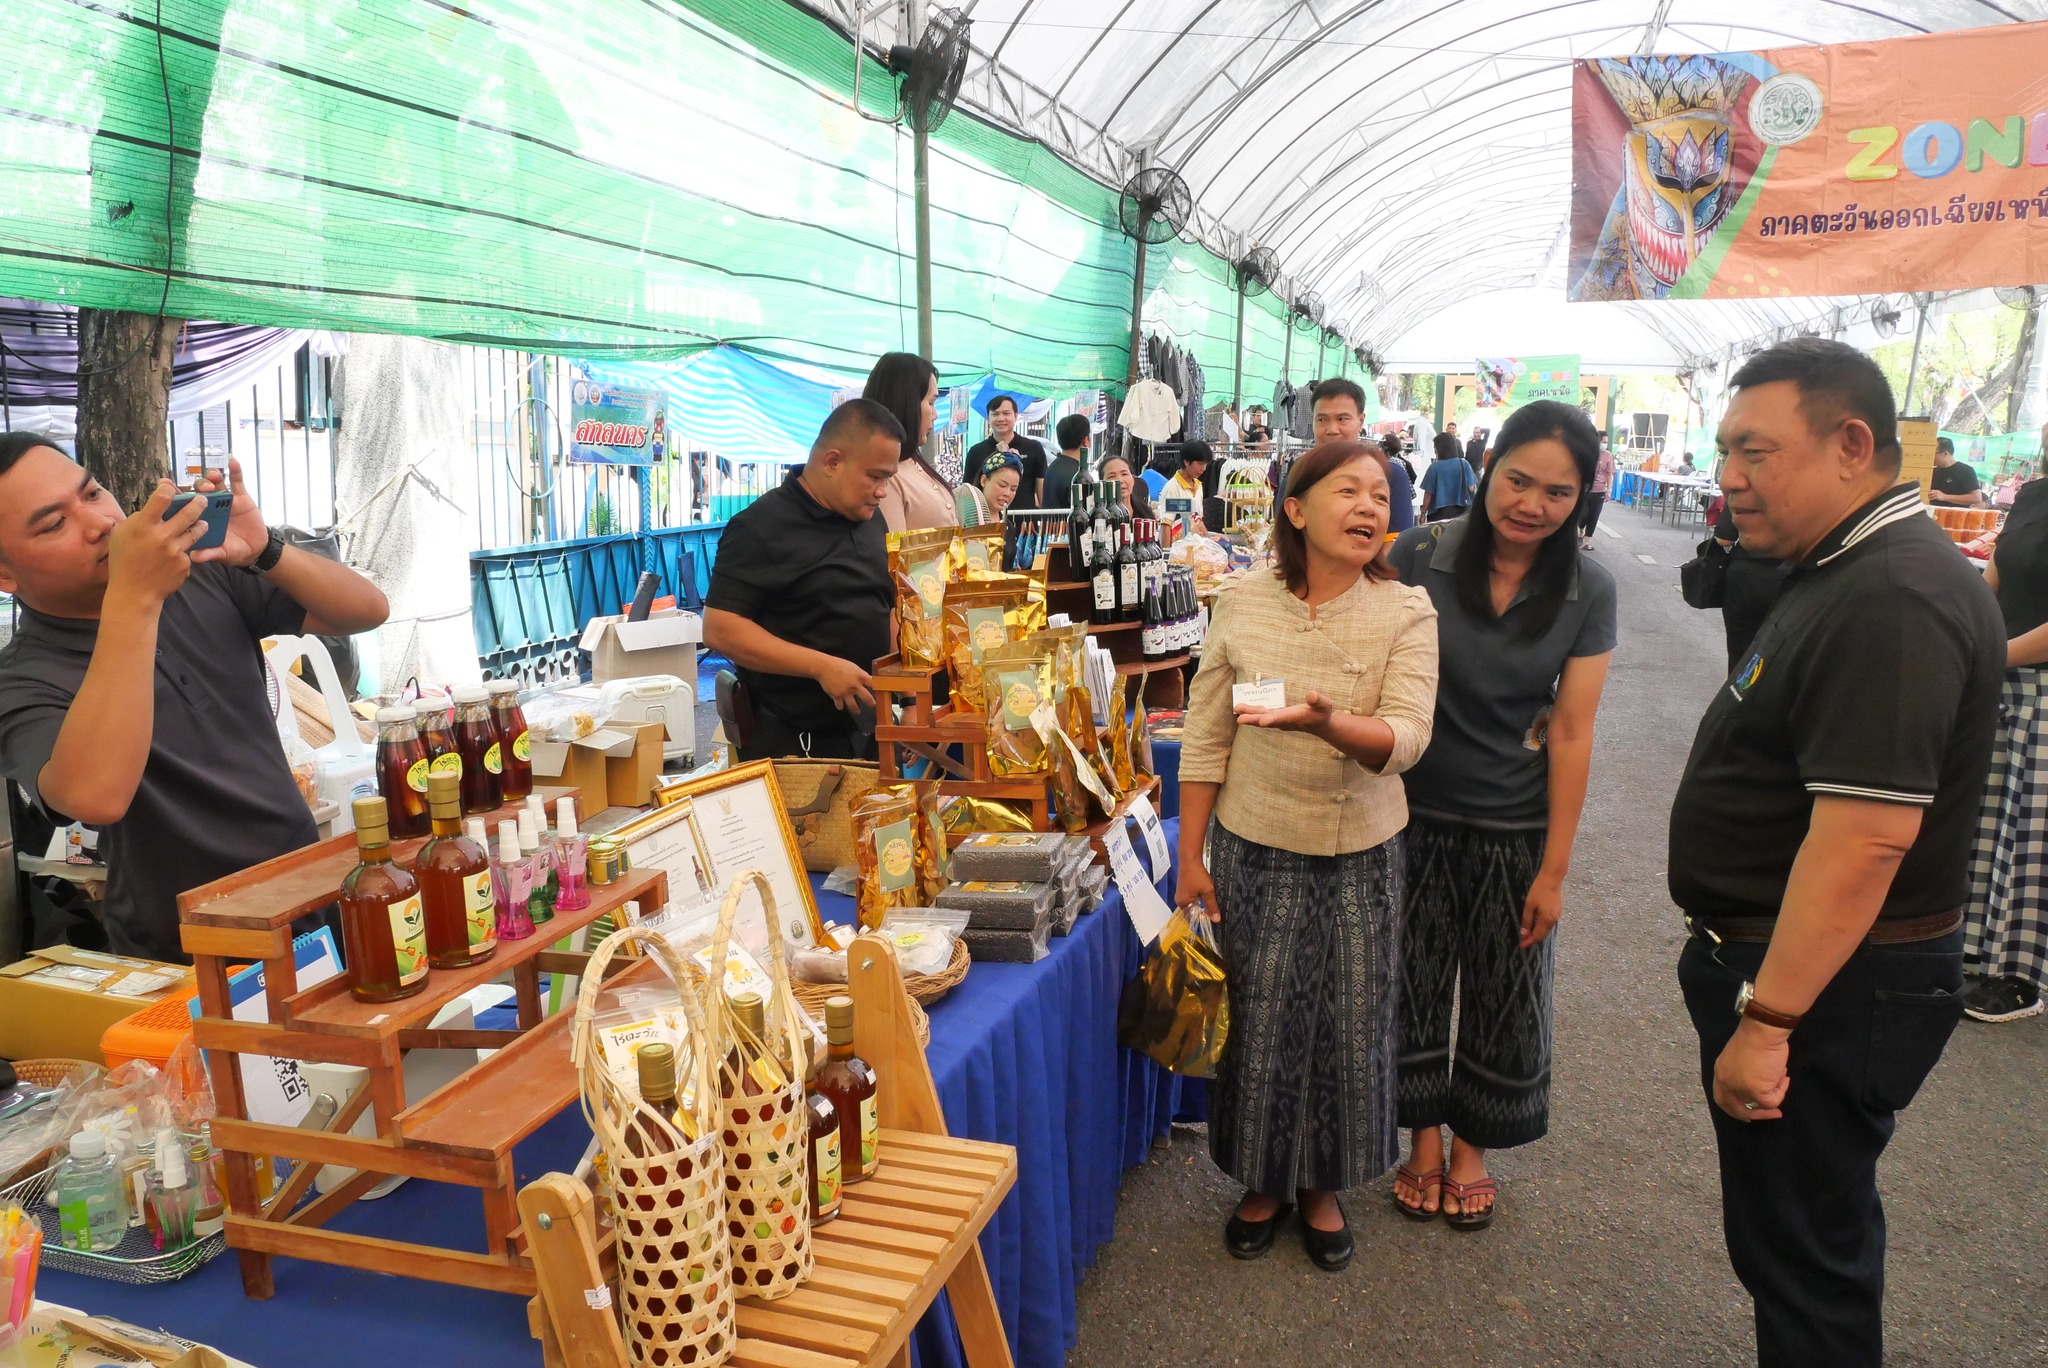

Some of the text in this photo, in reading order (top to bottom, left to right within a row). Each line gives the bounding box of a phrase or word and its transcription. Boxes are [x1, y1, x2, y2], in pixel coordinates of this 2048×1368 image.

[1530, 371, 1571, 383] ZONE
[1528, 385, 1570, 397] ภาคเหนือ
[576, 418, 648, 447] สกลนคร
